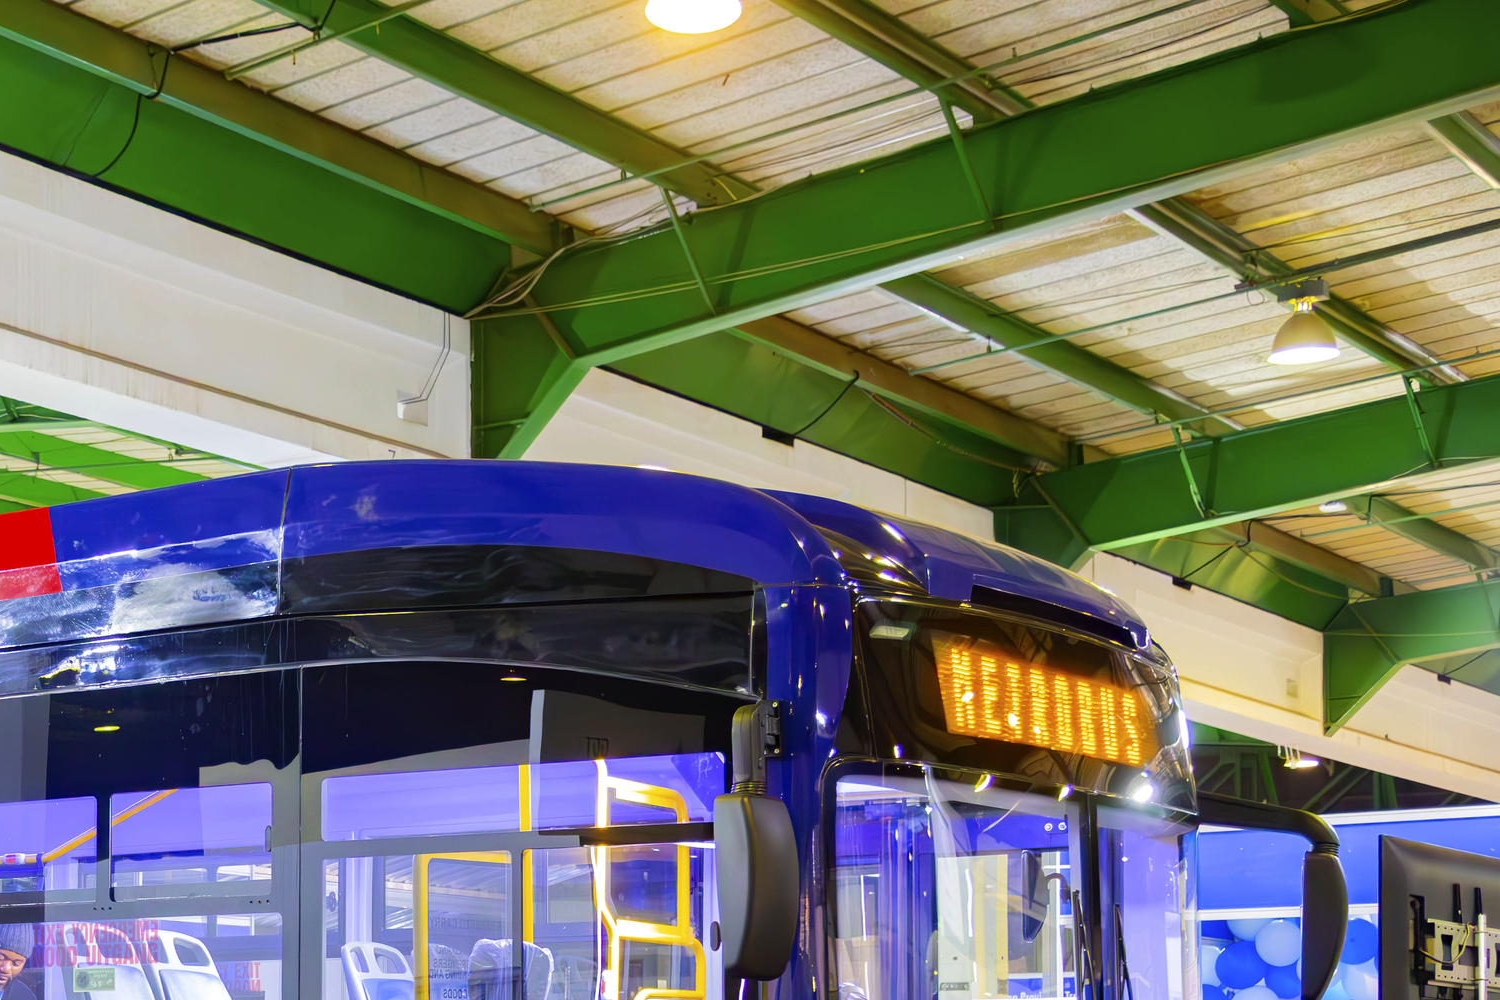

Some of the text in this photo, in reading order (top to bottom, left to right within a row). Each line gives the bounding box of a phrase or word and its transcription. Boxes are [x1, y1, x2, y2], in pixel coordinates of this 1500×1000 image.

[951, 648, 1141, 765] METROBUS
[32, 942, 159, 968] NOOD UITGANG
[234, 962, 261, 979] EXIT
